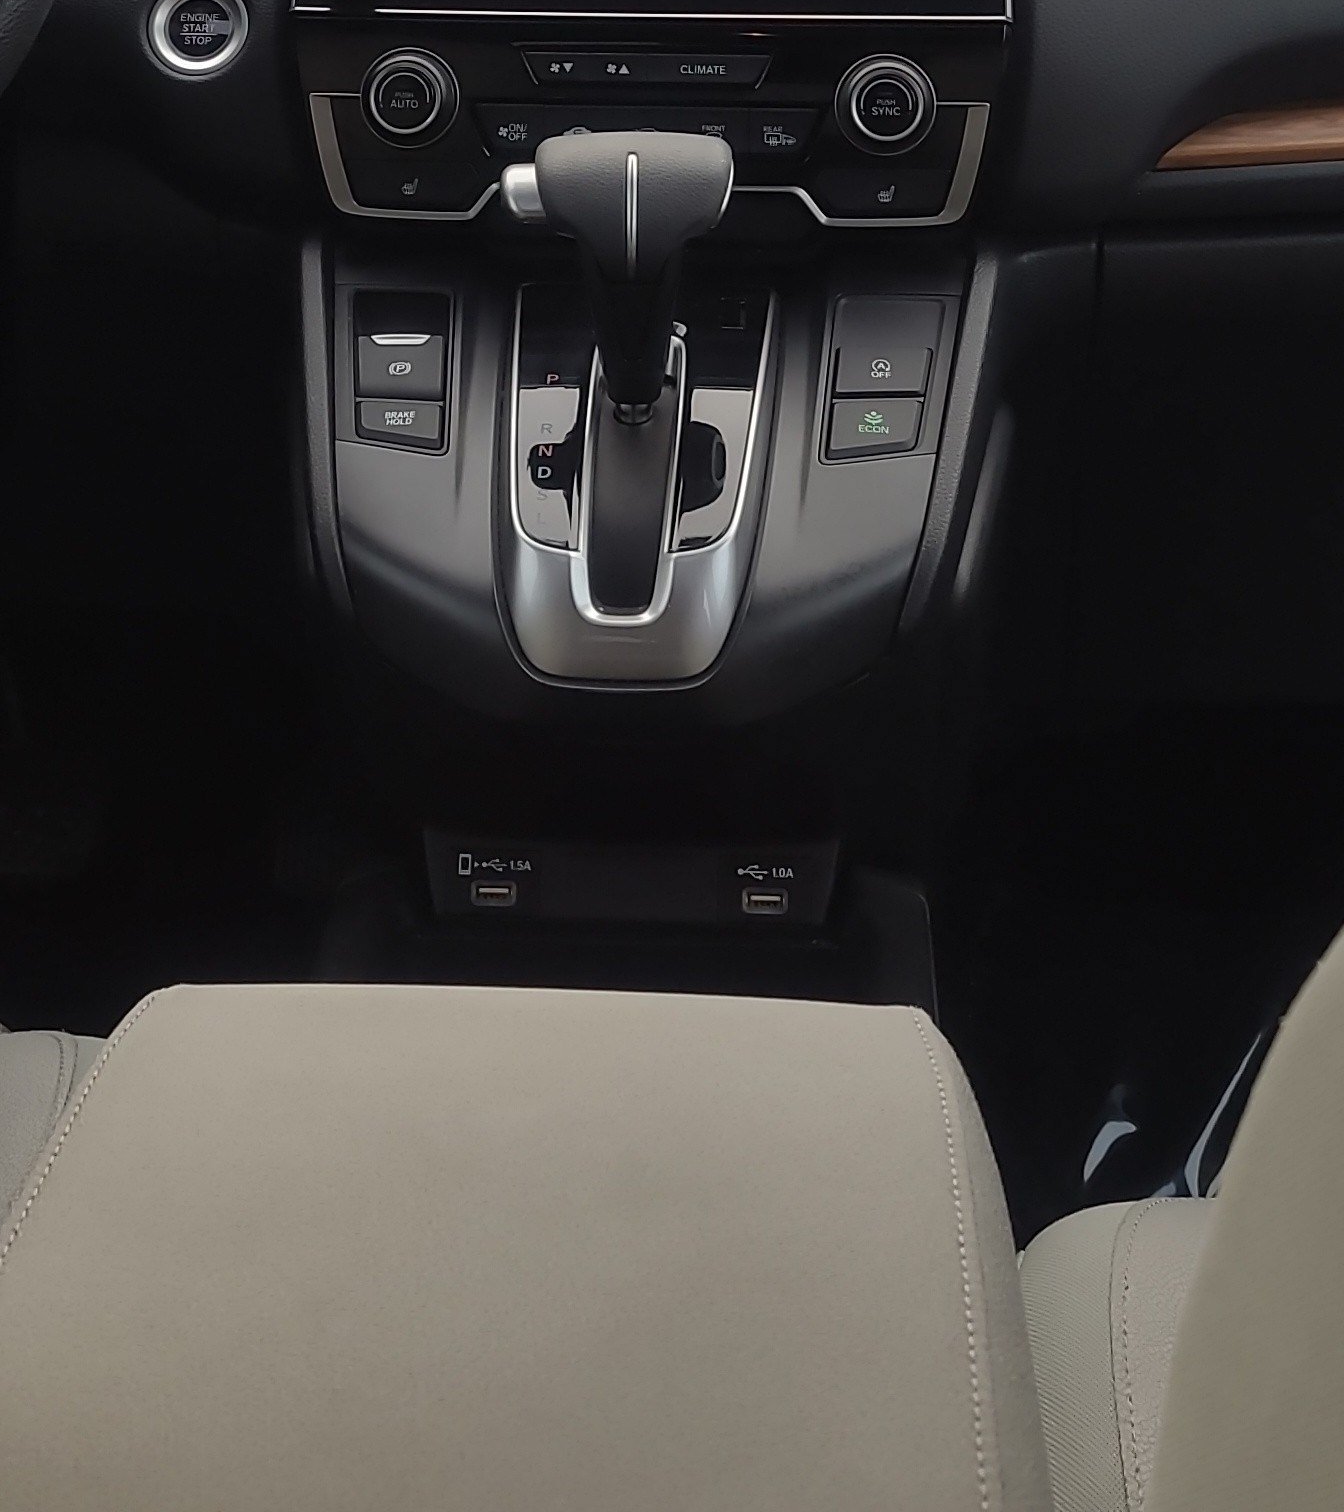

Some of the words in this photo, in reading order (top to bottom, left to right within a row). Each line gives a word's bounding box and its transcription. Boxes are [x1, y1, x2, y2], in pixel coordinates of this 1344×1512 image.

[180, 13, 221, 22] ENGINE
[182, 23, 216, 33] START
[183, 35, 213, 45] STOP
[680, 64, 727, 75] CLIMATE
[390, 99, 419, 109] AUTO
[876, 98, 896, 106] PUSH
[871, 106, 901, 116] SYNC
[701, 124, 726, 132] FRONT
[763, 125, 784, 133] REAR
[508, 132, 528, 141] OFF
[546, 374, 560, 385] P
[871, 371, 892, 379] OFF
[384, 411, 416, 419] BRAKE
[386, 417, 413, 426] HOLD
[541, 423, 553, 434] R
[858, 424, 890, 434] ECON
[538, 445, 553, 457] N
[537, 466, 552, 479] D
